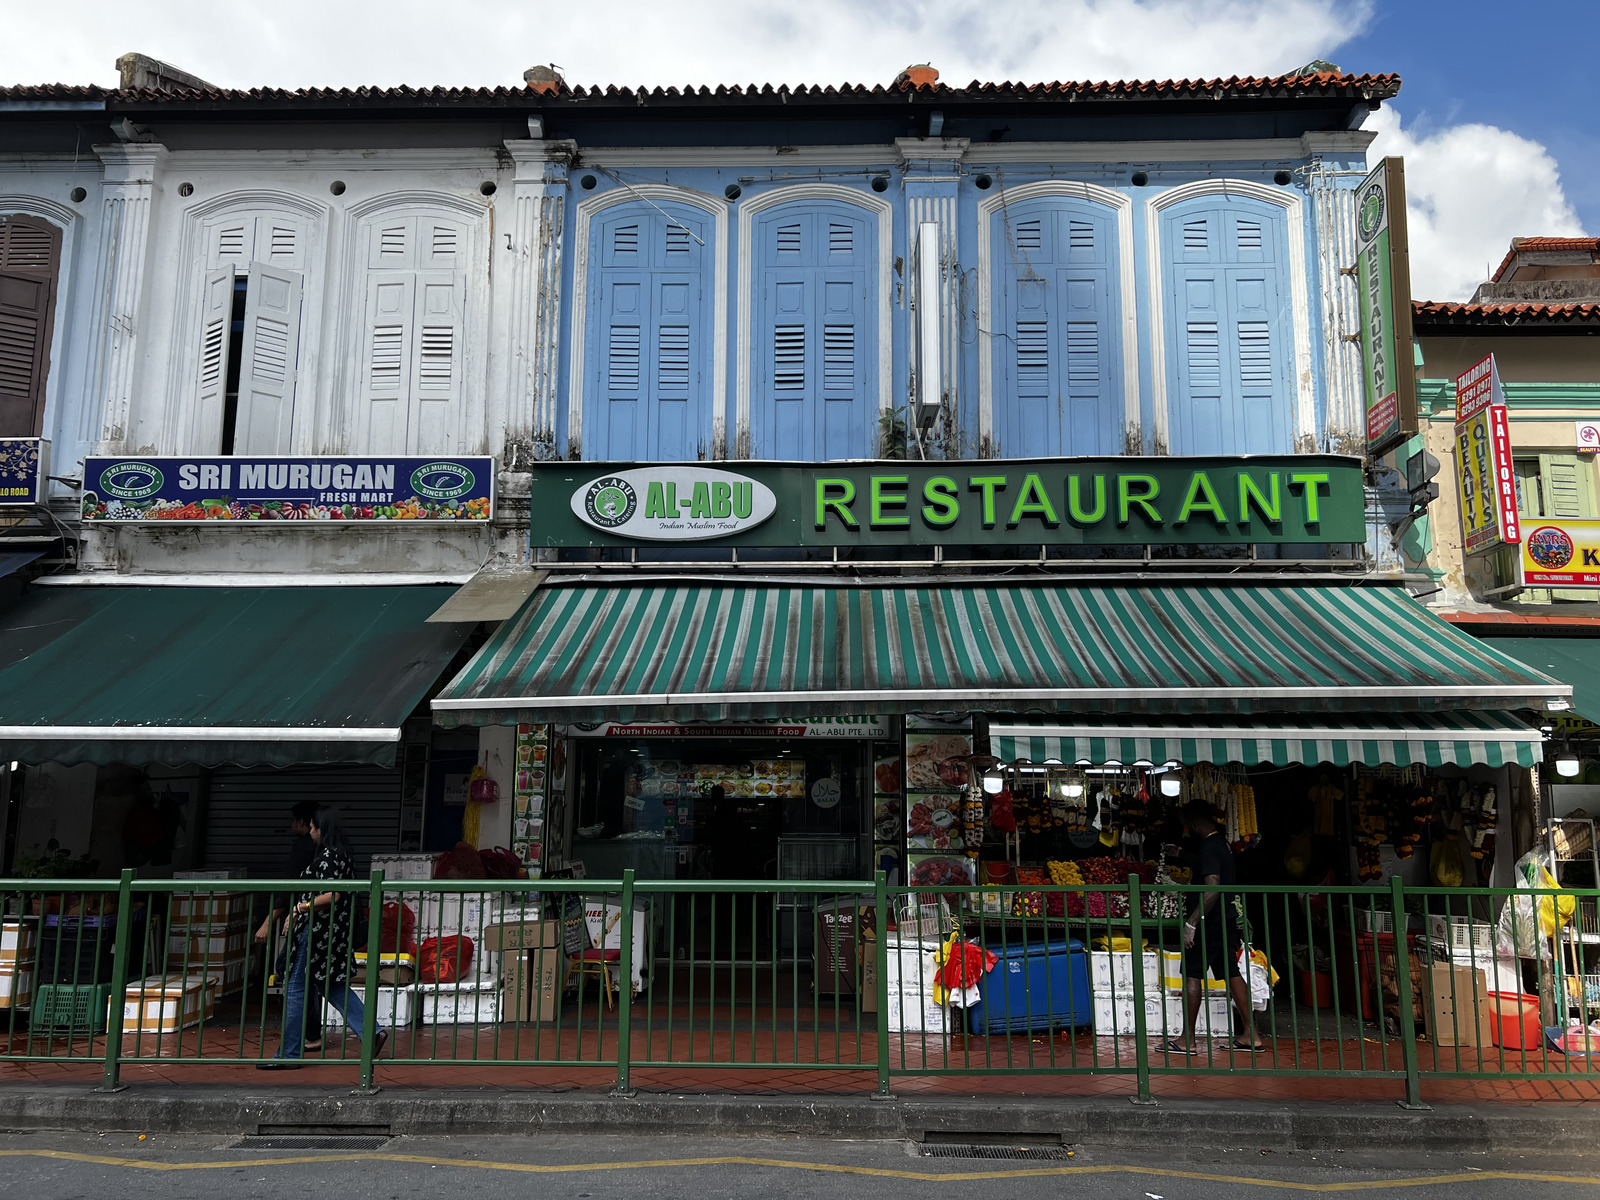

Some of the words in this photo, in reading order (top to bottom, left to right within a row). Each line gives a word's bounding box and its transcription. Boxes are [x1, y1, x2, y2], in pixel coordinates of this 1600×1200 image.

[1367, 243, 1385, 399] RESTAURANT
[1458, 357, 1491, 391] TAILORING
[1461, 387, 1476, 404] 6291
[1477, 376, 1491, 394] 0977
[1461, 399, 1475, 417] 6293
[106, 467, 119, 478] SRI
[120, 464, 157, 477] MURUGAN
[178, 464, 231, 490] SRI
[239, 464, 395, 490] MURUGAN
[417, 467, 430, 478] SRI
[431, 464, 468, 477] MURUGAN
[1472, 423, 1494, 524] QUEEN'S
[1494, 409, 1517, 539] TAILORING
[591, 478, 633, 496] AL-ABU
[1459, 433, 1477, 529] BEAUTY
[10, 488, 29, 496] ROAD
[111, 487, 133, 497] SINCE
[134, 487, 151, 497] 1969
[320, 492, 356, 503] FRESH
[360, 492, 394, 503] MART
[421, 487, 444, 497] SINCE
[445, 487, 462, 497] 1969
[644, 481, 753, 519] AL-ABU
[813, 469, 1331, 530] RESTAURANT
[587, 501, 611, 526] Restaurant
[616, 501, 637, 525] Catering
[659, 521, 685, 530] Indian
[686, 521, 716, 530] Muslim
[717, 521, 739, 530] Food
[1532, 534, 1569, 546] KVRS
[1563, 717, 1599, 727] Tra
[612, 727, 641, 735] NORTH
[643, 727, 671, 735] INDIAN
[673, 727, 681, 735] &
[683, 727, 711, 735] SOUTH
[712, 727, 741, 735] INDIAN
[743, 727, 775, 736] MUSLIM
[777, 727, 800, 736] FOOD
[848, 728, 865, 736] PTE.
[868, 728, 887, 736] LTD.
[823, 913, 853, 924] Tazee
